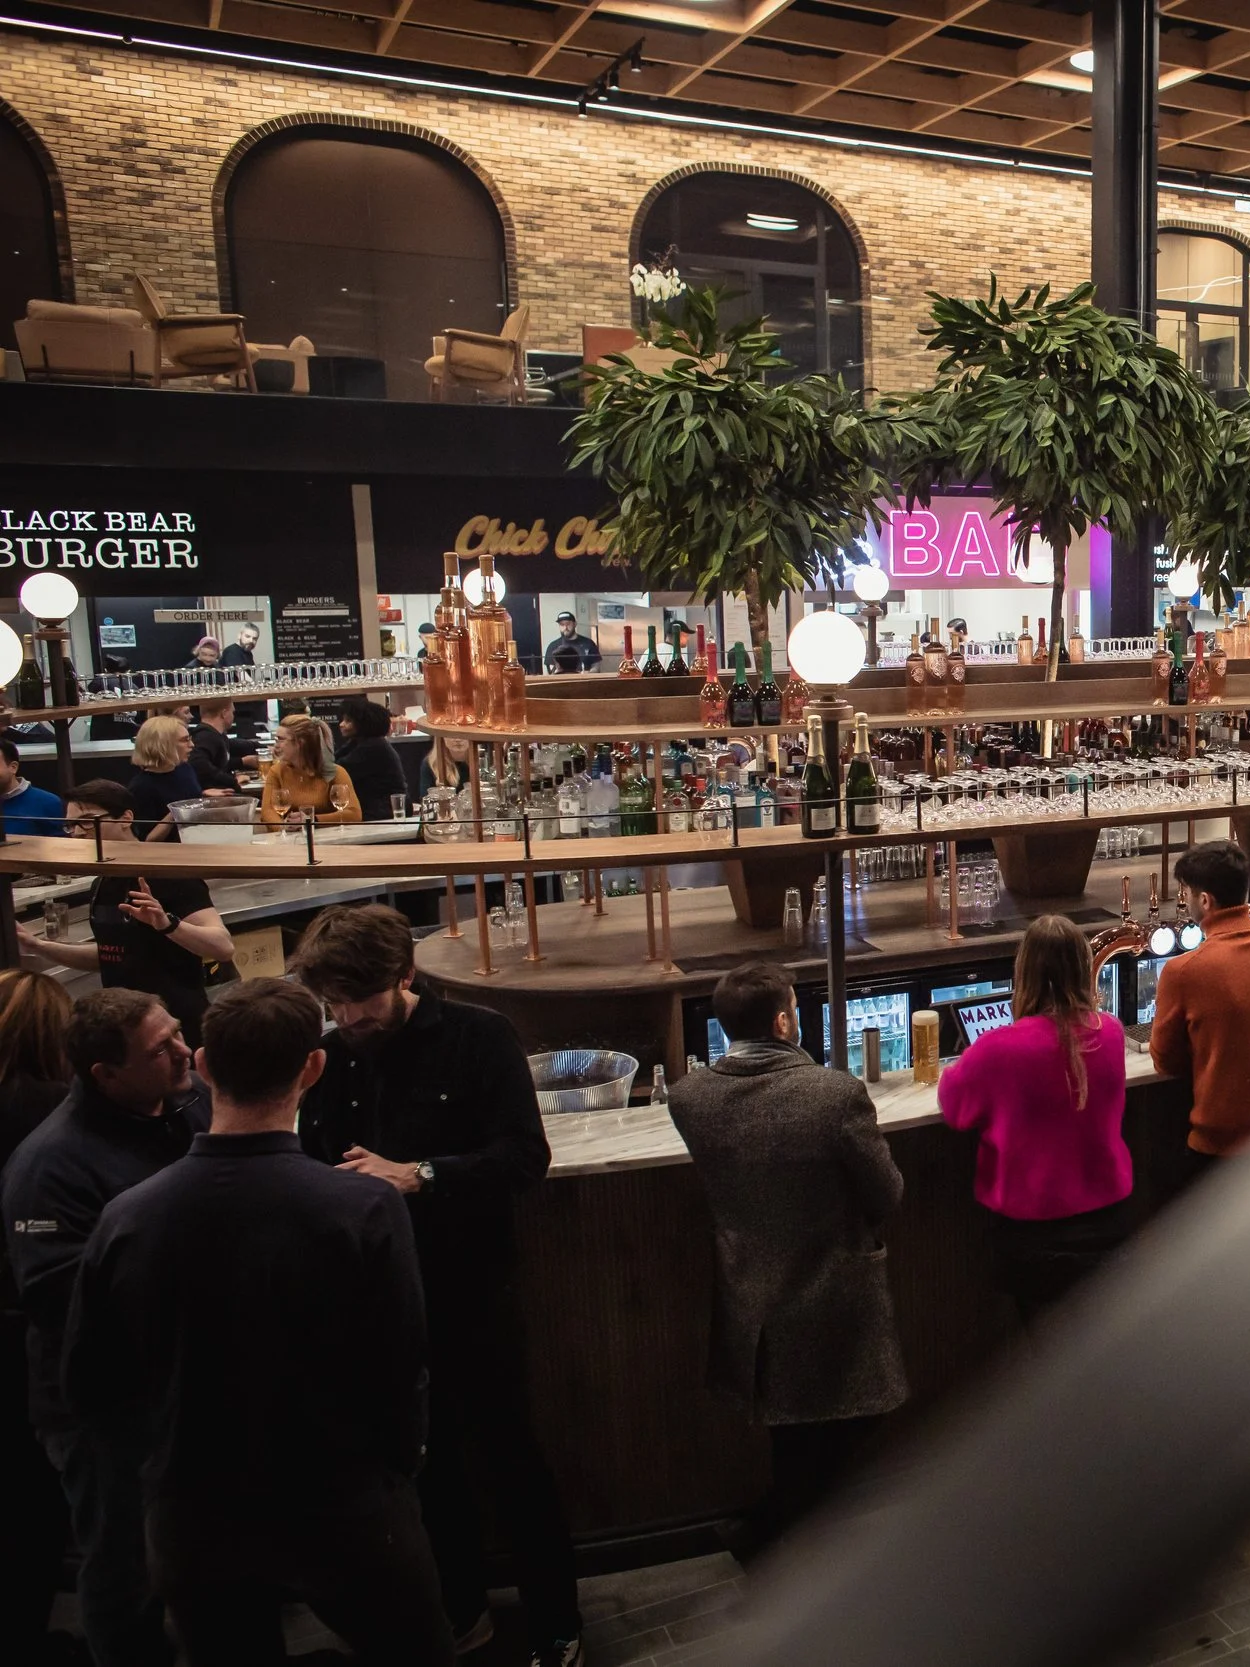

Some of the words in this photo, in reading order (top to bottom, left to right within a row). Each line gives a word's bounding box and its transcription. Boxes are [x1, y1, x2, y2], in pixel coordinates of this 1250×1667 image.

[0, 510, 98, 531] LACK
[103, 511, 196, 533] BEAR
[455, 515, 549, 559] Chick
[0, 537, 199, 569] BURGER
[297, 596, 335, 604] BURGERS
[174, 611, 213, 621] ORDER
[217, 611, 249, 621] HERE
[960, 1001, 1012, 1025] MARK
